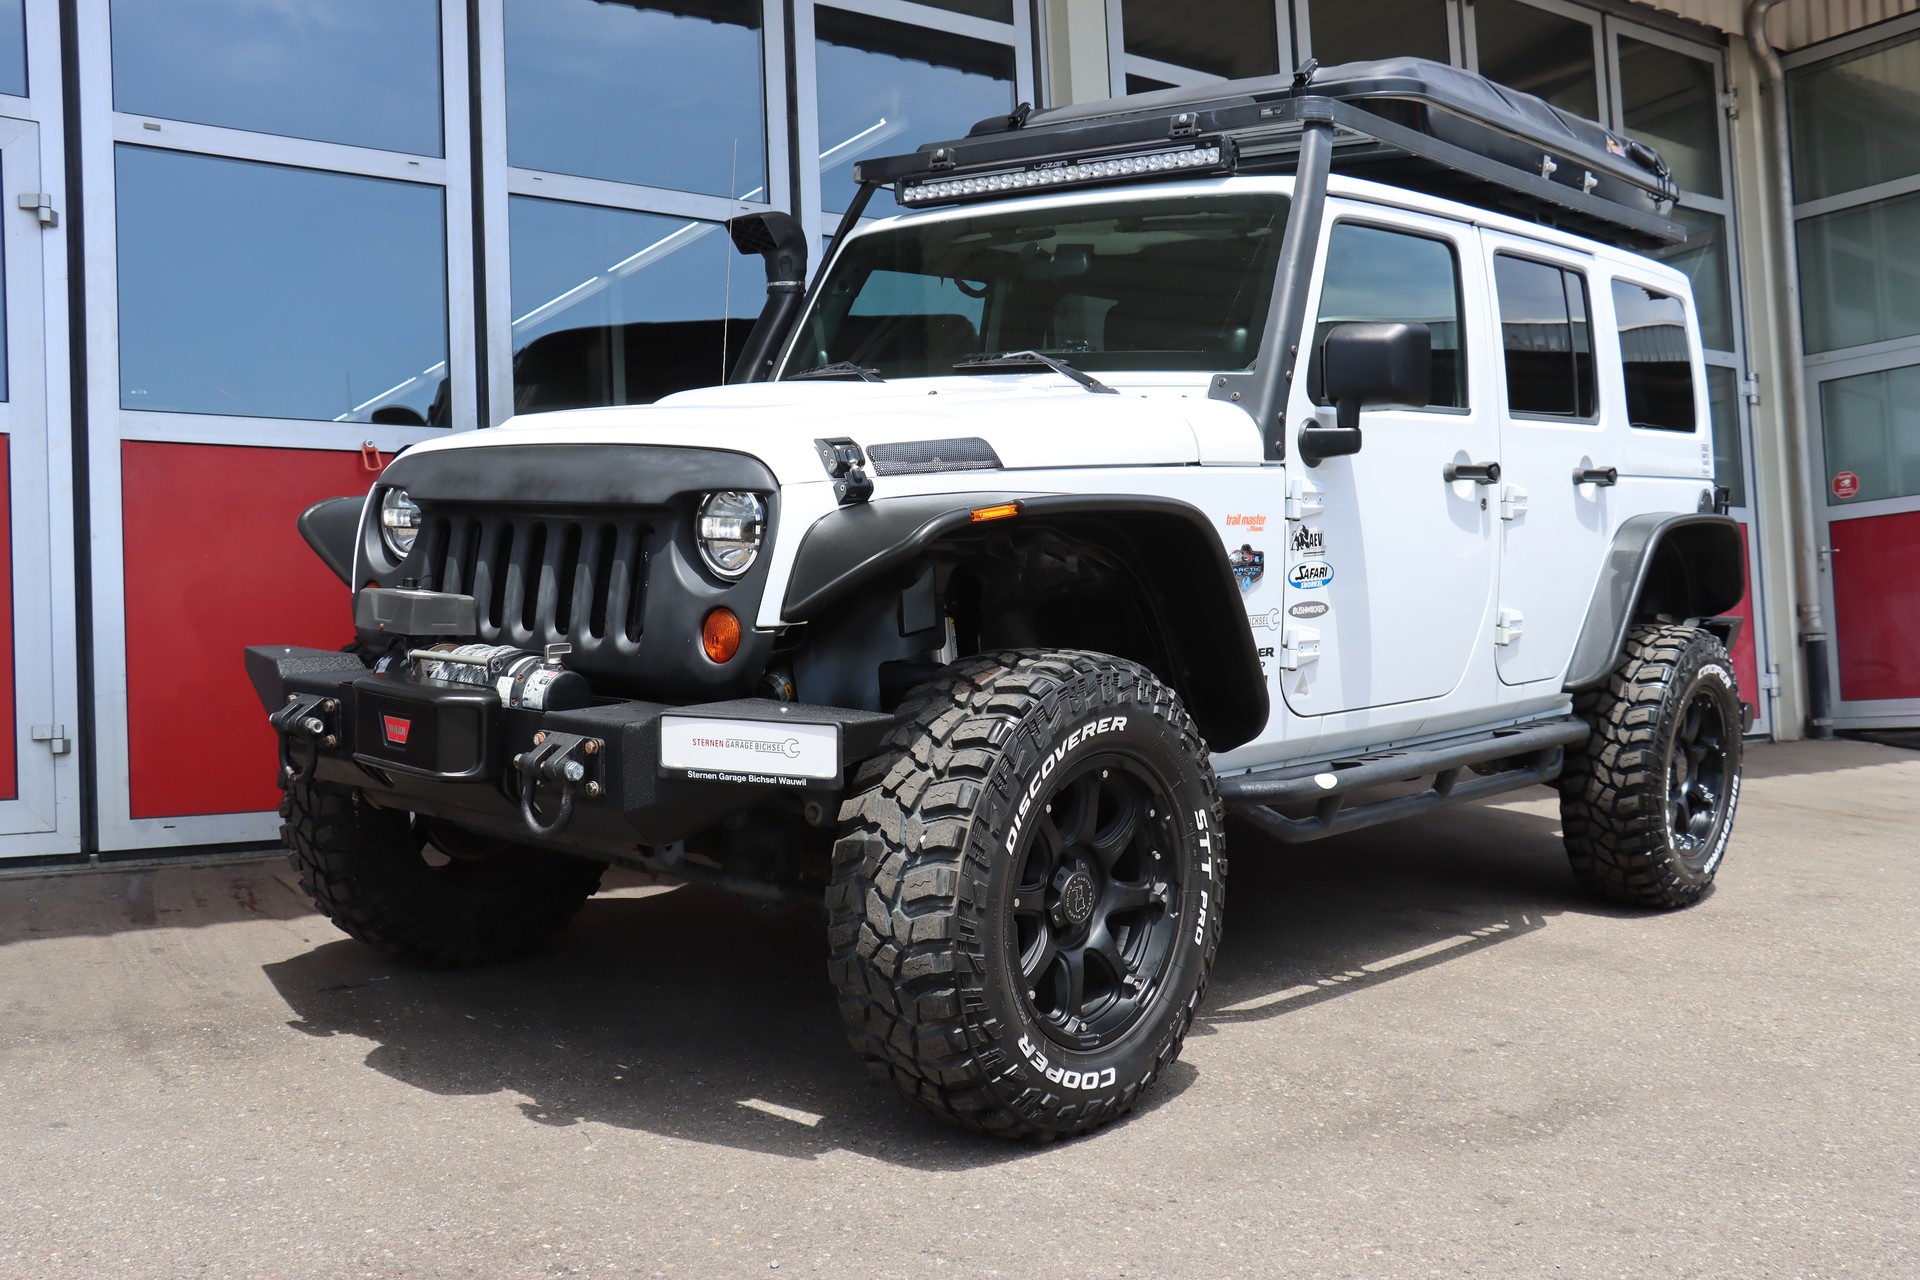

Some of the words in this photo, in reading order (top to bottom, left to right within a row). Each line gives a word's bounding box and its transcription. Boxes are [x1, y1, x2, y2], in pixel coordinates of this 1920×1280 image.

[1033, 160, 1068, 170] LAZER
[1226, 514, 1241, 526] trail
[1241, 514, 1267, 526] master
[1309, 532, 1323, 547] AEV
[1295, 565, 1328, 581] SAFARI
[692, 738, 724, 748] STERNEN
[725, 740, 754, 750] GARAGE
[754, 742, 785, 752] BICHSEL
[687, 770, 717, 780] Sternen
[718, 772, 747, 783] Garage
[748, 774, 777, 784] Bichsel
[778, 776, 807, 786] Wauwil
[1005, 716, 1128, 856] DISCOVERER
[1194, 808, 1212, 881] STT
[1194, 890, 1208, 946] PRO
[1017, 1032, 1116, 1091] COOPER
